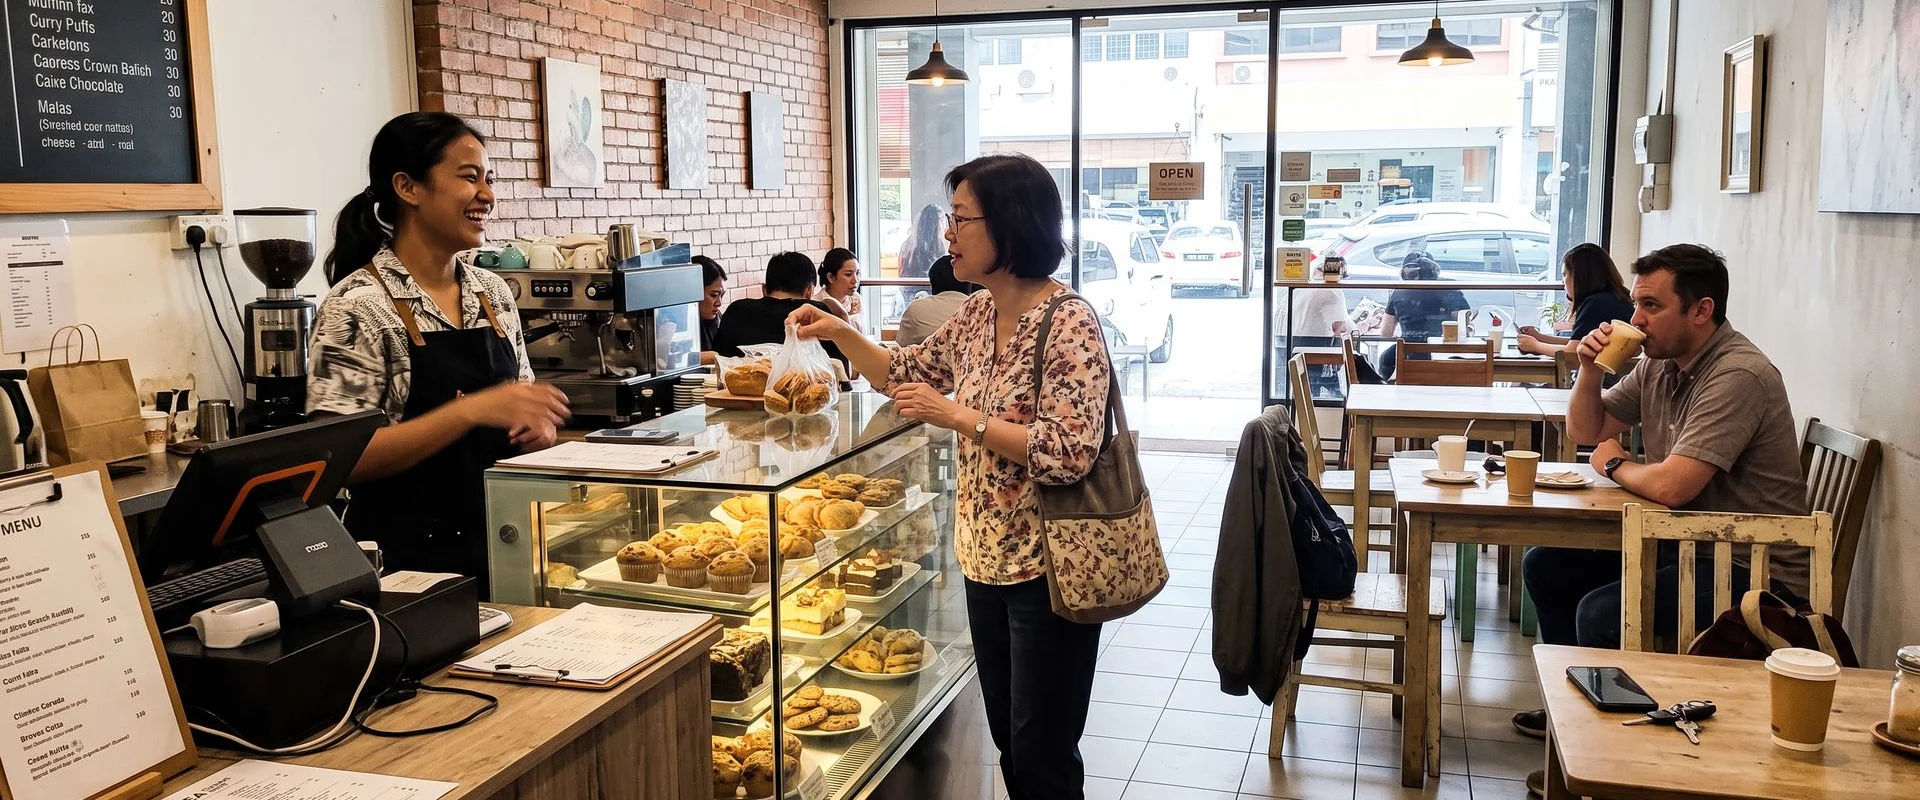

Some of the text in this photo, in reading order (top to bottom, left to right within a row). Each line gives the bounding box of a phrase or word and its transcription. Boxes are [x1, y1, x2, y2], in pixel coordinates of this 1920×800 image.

[29, 13, 176, 42] Curry Puffs 30
[161, 11, 175, 25] 20
[164, 48, 178, 61] 30
[83, 58, 119, 74] Crown
[166, 66, 179, 80] 30
[69, 76, 124, 94] Chocolate
[167, 85, 181, 98] 30
[38, 99, 182, 119] Malas 30
[41, 137, 76, 149] cheese
[1159, 168, 1194, 179] OPEN
[1, 515, 42, 536] MENU
